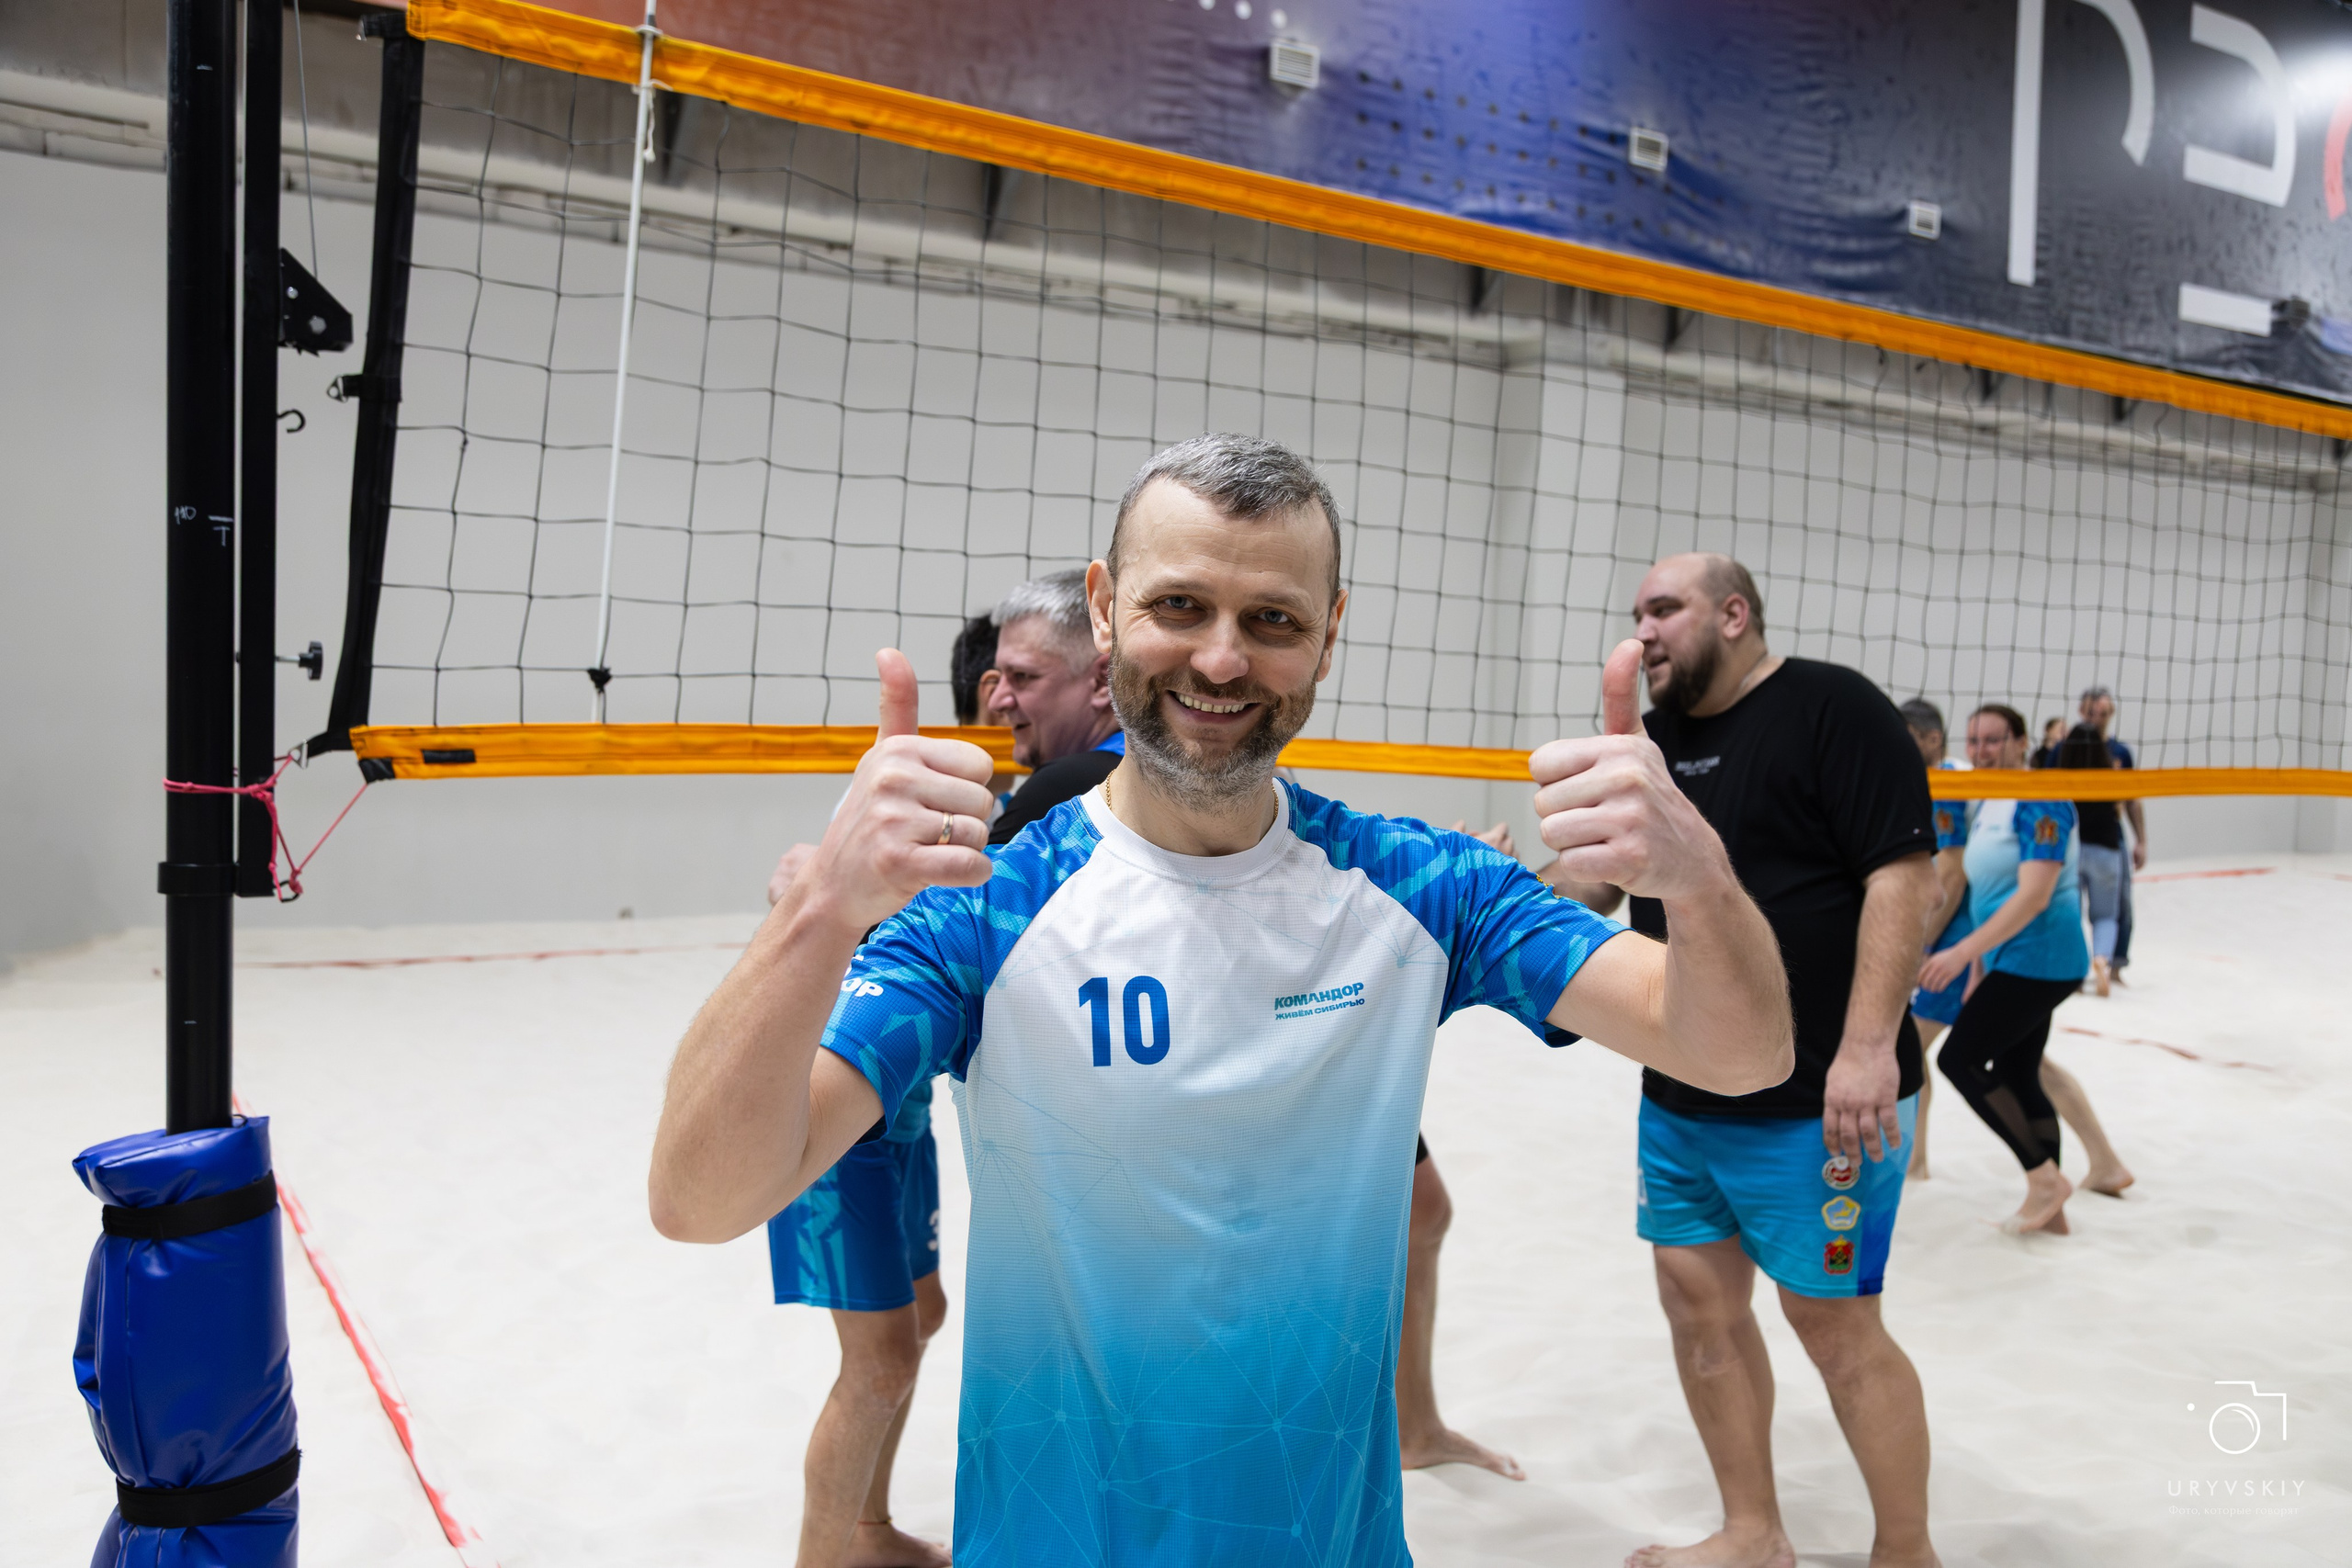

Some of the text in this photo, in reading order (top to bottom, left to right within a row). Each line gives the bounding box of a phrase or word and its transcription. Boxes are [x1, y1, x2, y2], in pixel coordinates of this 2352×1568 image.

[1274, 982, 1364, 1011] КОМАНДОР
[1274, 998, 1366, 1021] ЖИВЁМ СИБИРЬЮ
[1078, 975, 1170, 1067] 10
